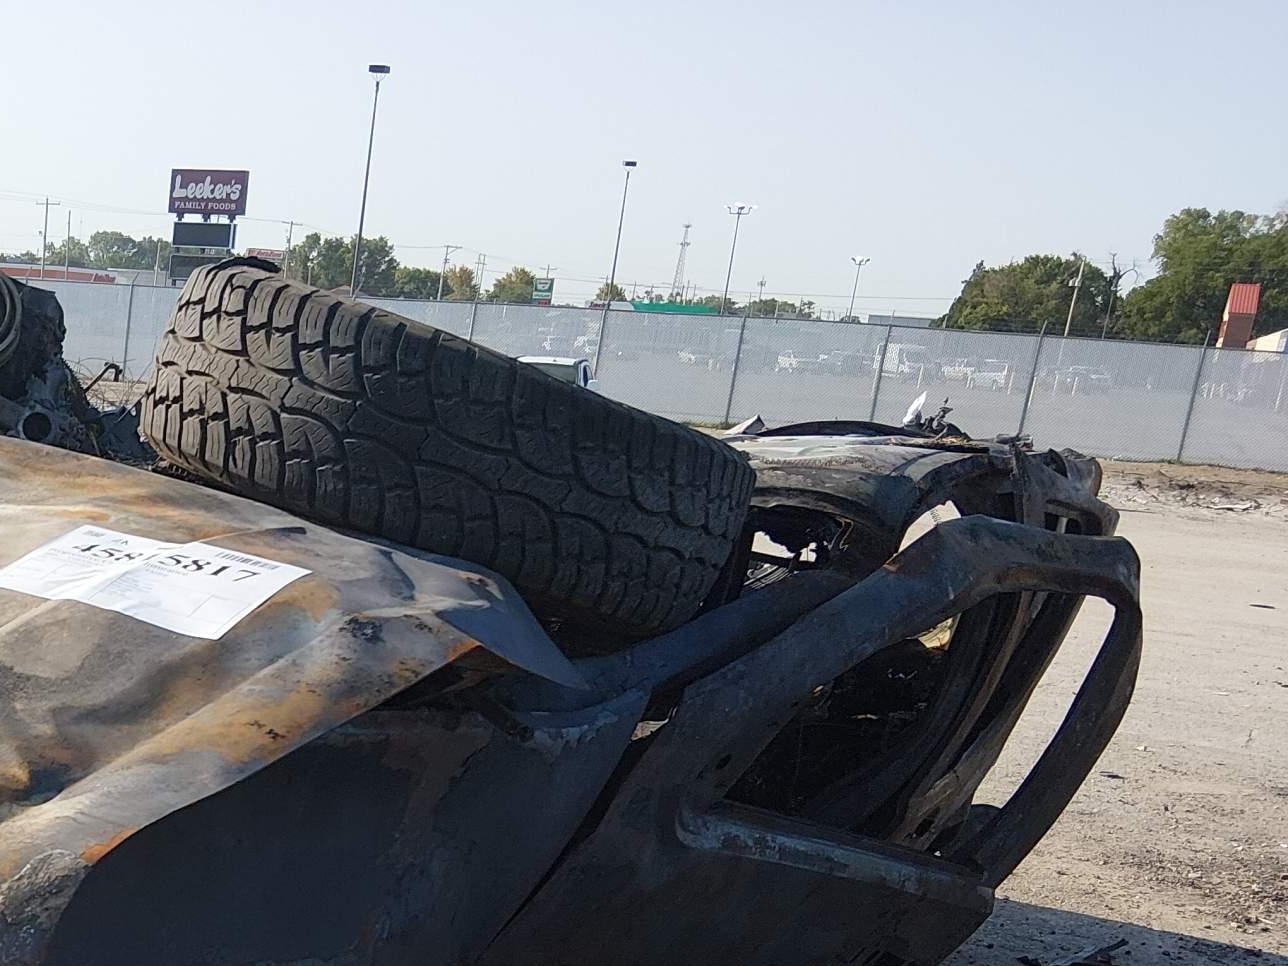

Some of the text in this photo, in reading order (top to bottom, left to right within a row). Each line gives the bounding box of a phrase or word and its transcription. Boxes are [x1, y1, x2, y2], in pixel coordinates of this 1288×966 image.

[173, 174, 242, 200] Leeker's
[174, 201, 236, 210] FAMILY FOODS
